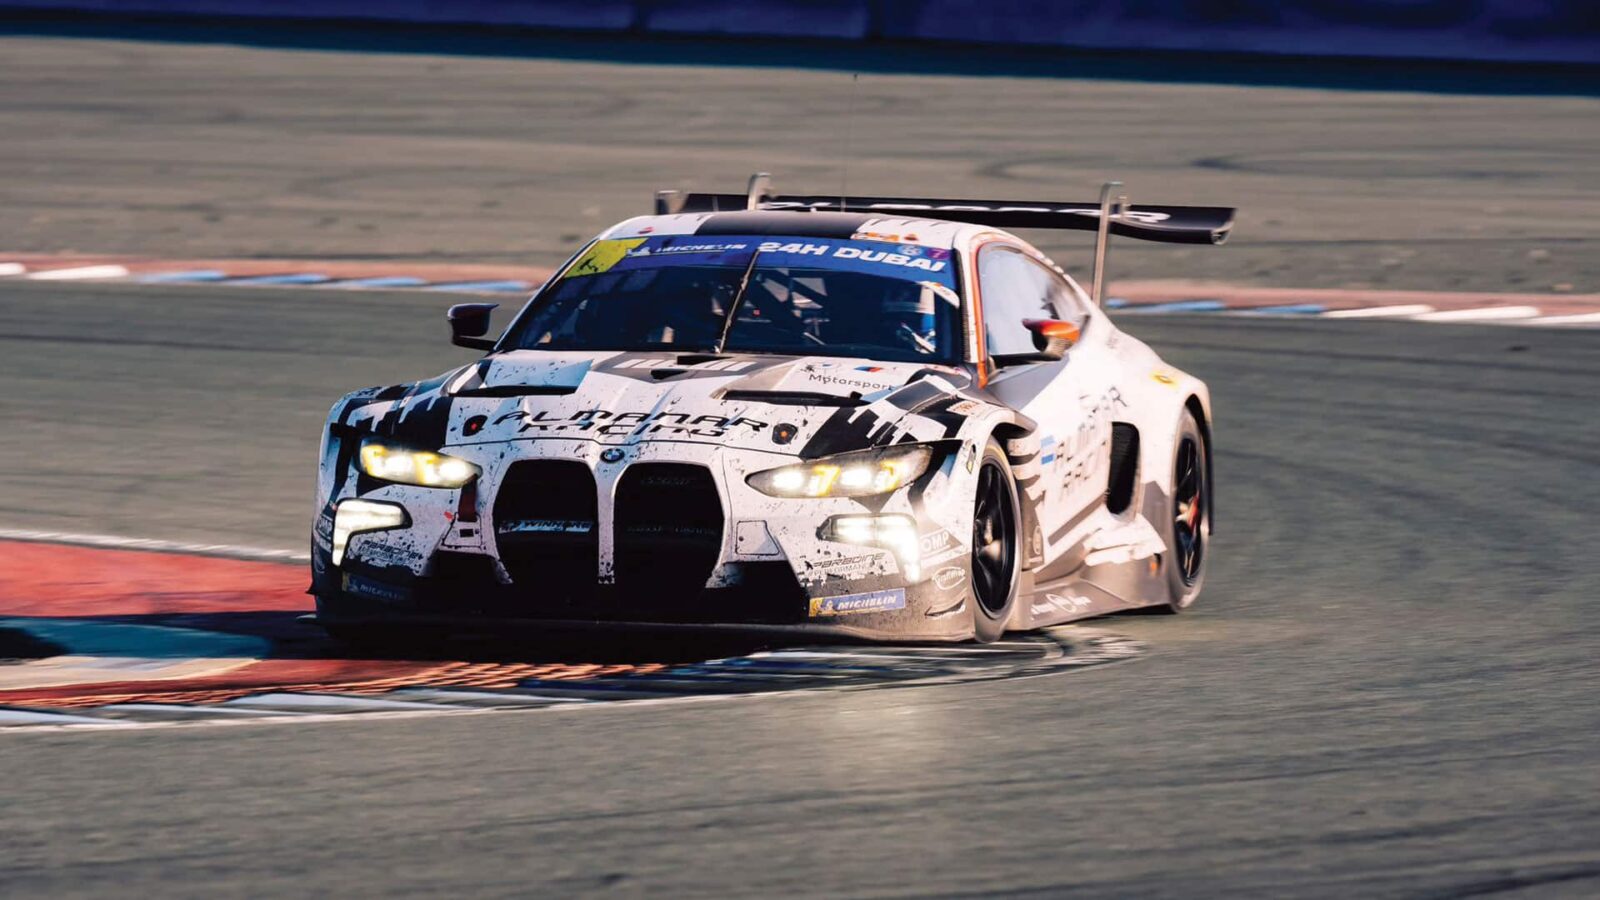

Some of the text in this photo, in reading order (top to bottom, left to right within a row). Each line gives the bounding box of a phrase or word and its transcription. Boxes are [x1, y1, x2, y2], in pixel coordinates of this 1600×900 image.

[758, 241, 829, 255] 24H
[833, 247, 946, 272] DUBAI
[492, 410, 769, 431] ALMANAR
[921, 530, 950, 553] OMP
[838, 595, 897, 611] MICHELIN
